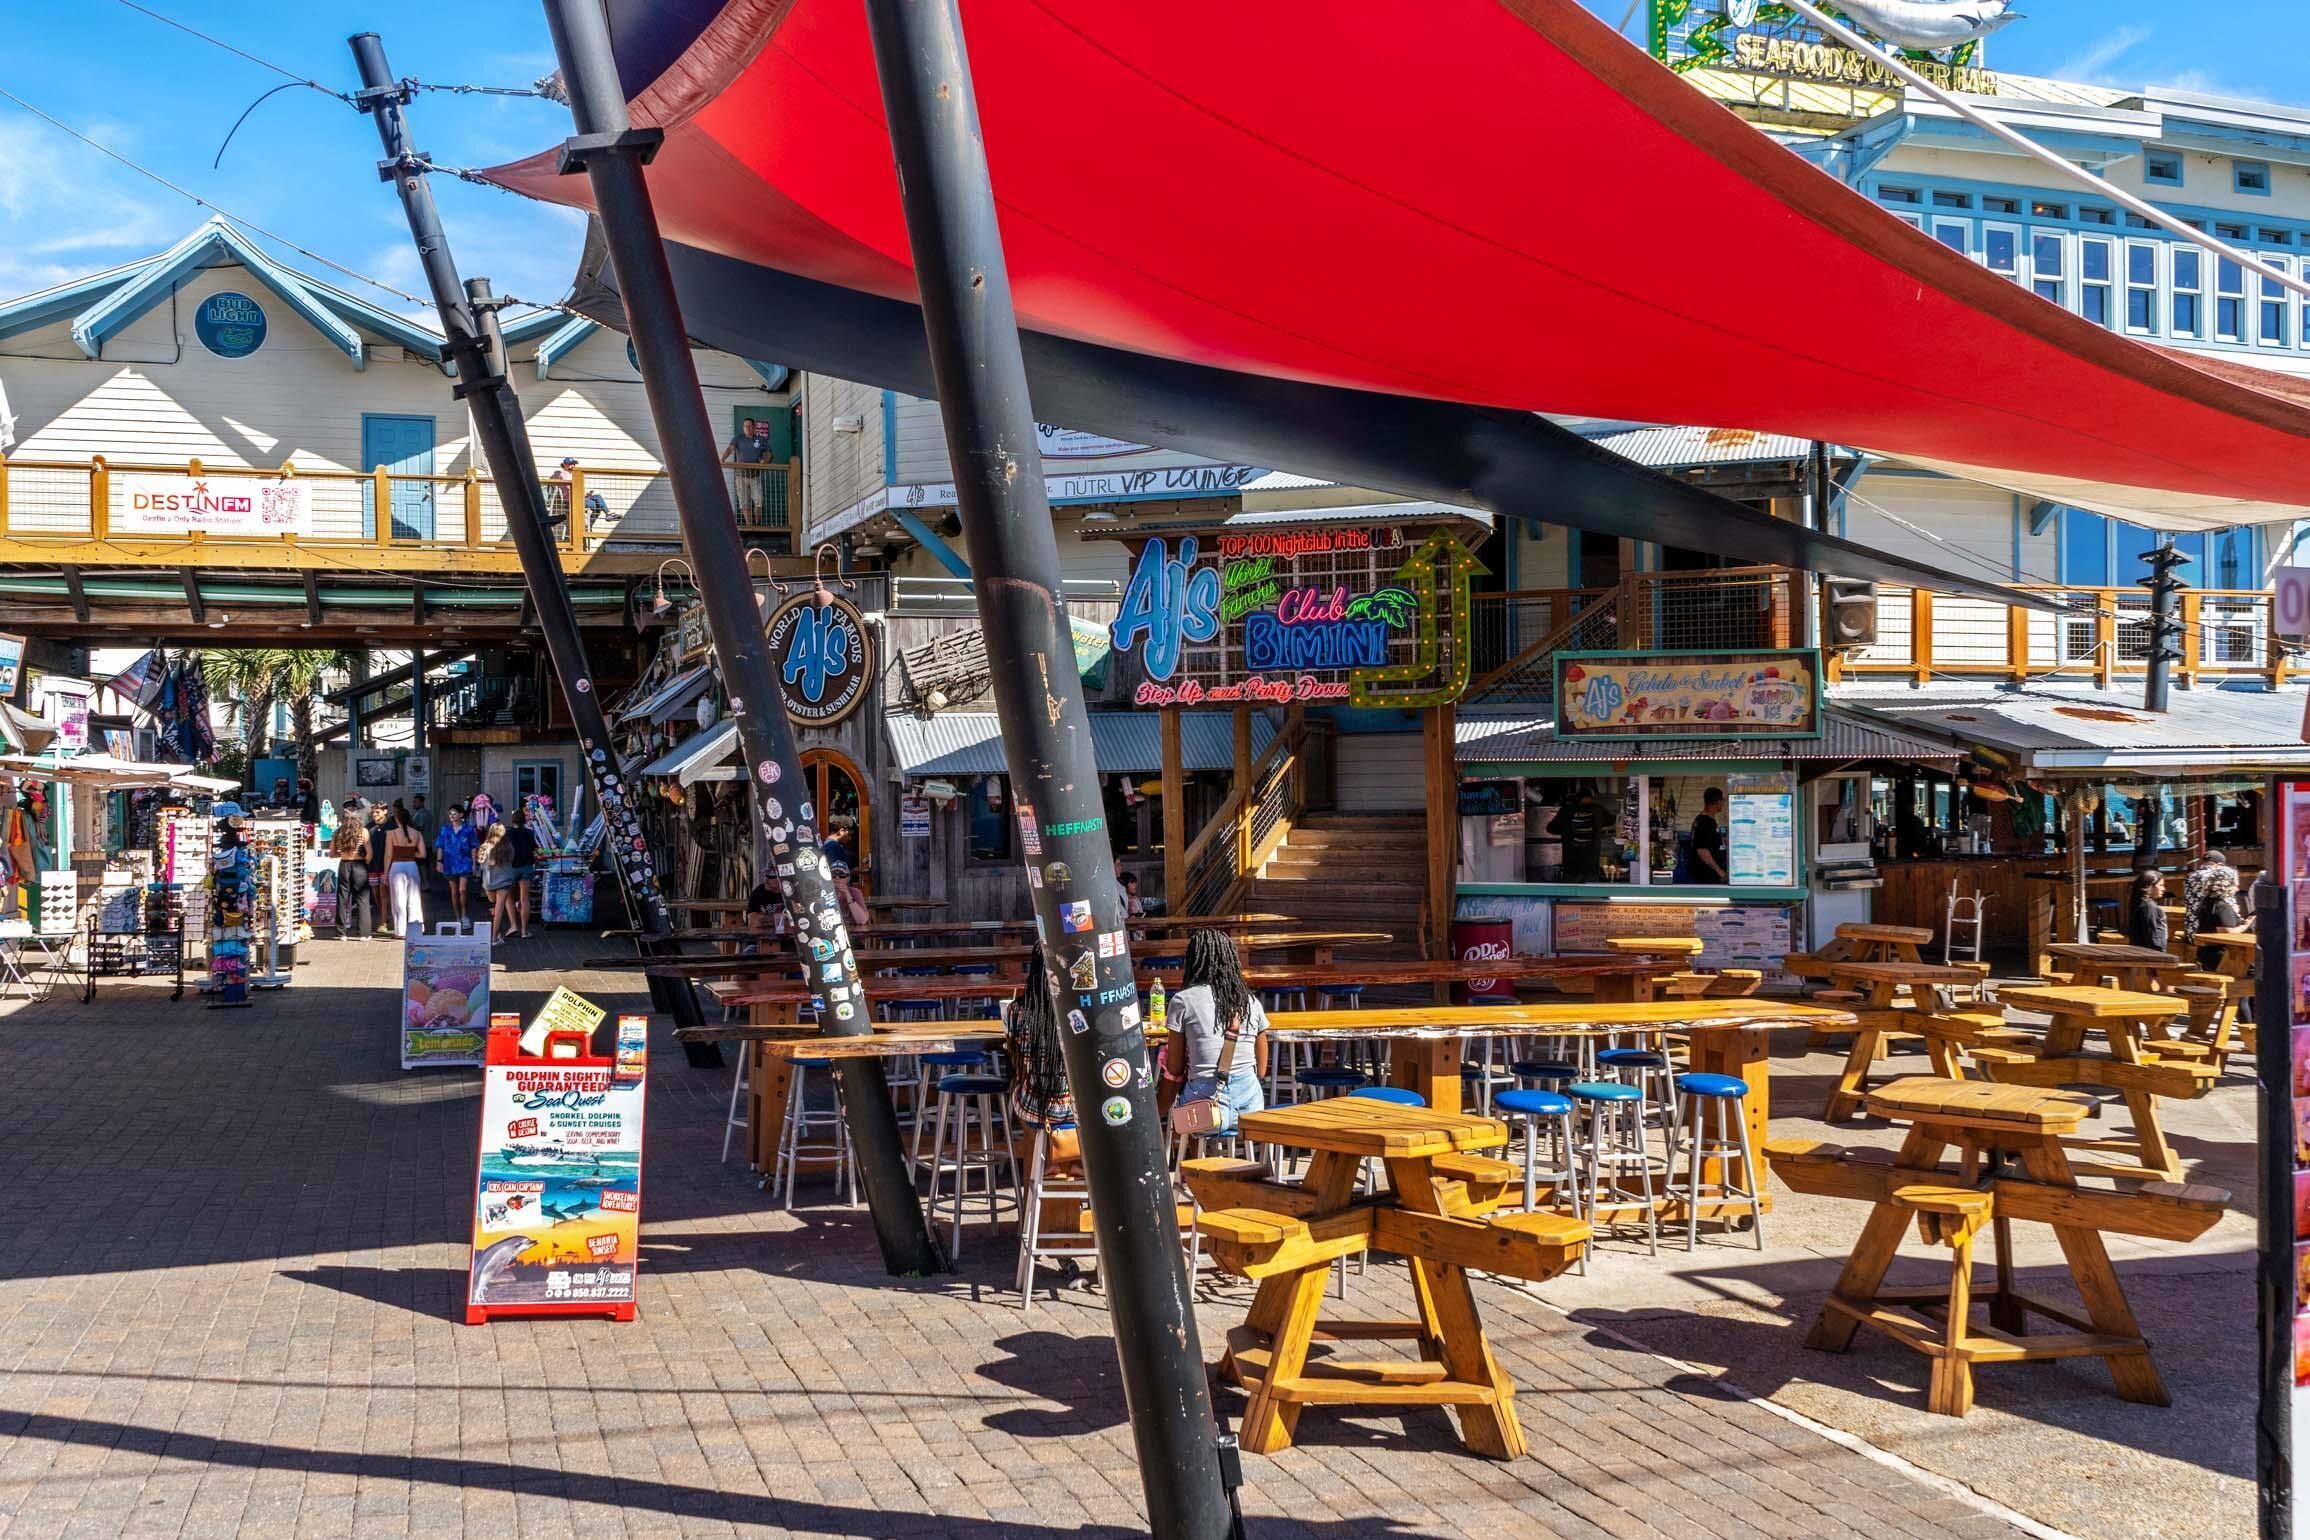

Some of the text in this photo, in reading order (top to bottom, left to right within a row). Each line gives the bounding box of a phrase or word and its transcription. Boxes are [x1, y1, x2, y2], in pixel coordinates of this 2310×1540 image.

[1736, 33, 1842, 79] SEAFOOD
[1849, 48, 1865, 78] &
[1955, 66, 1998, 96] BAR
[210, 309, 257, 322] LIGHT
[217, 297, 252, 310] BUD
[1121, 472, 1156, 493] VIP
[1166, 466, 1254, 489] LOUNGE
[134, 491, 249, 512] DESTIN FM
[1219, 536, 1246, 555] TOP
[1250, 535, 1271, 554] 100
[1273, 533, 1331, 557] Nightclub
[1372, 528, 1401, 547] USA
[1225, 558, 1274, 587] World
[1222, 580, 1278, 622] Famous
[1278, 586, 1346, 624] Club
[769, 607, 862, 664] WORLD FAMOUS
[1247, 615, 1388, 669] BIMINI
[787, 674, 861, 718] OYSTER & SUSHI BAR
[1136, 676, 1350, 706] Step Up and Party Down
[1628, 670, 1749, 697] Gelato & Sorbet
[1045, 817, 1103, 836] HEFFNASTY
[1480, 943, 1498, 956] Dr
[562, 992, 599, 1018] DOLPHIN
[506, 1071, 614, 1081] DOLPHIN SIGHTIN
[524, 1089, 605, 1111] SeaQuest
[503, 1182, 517, 1192] CAN
